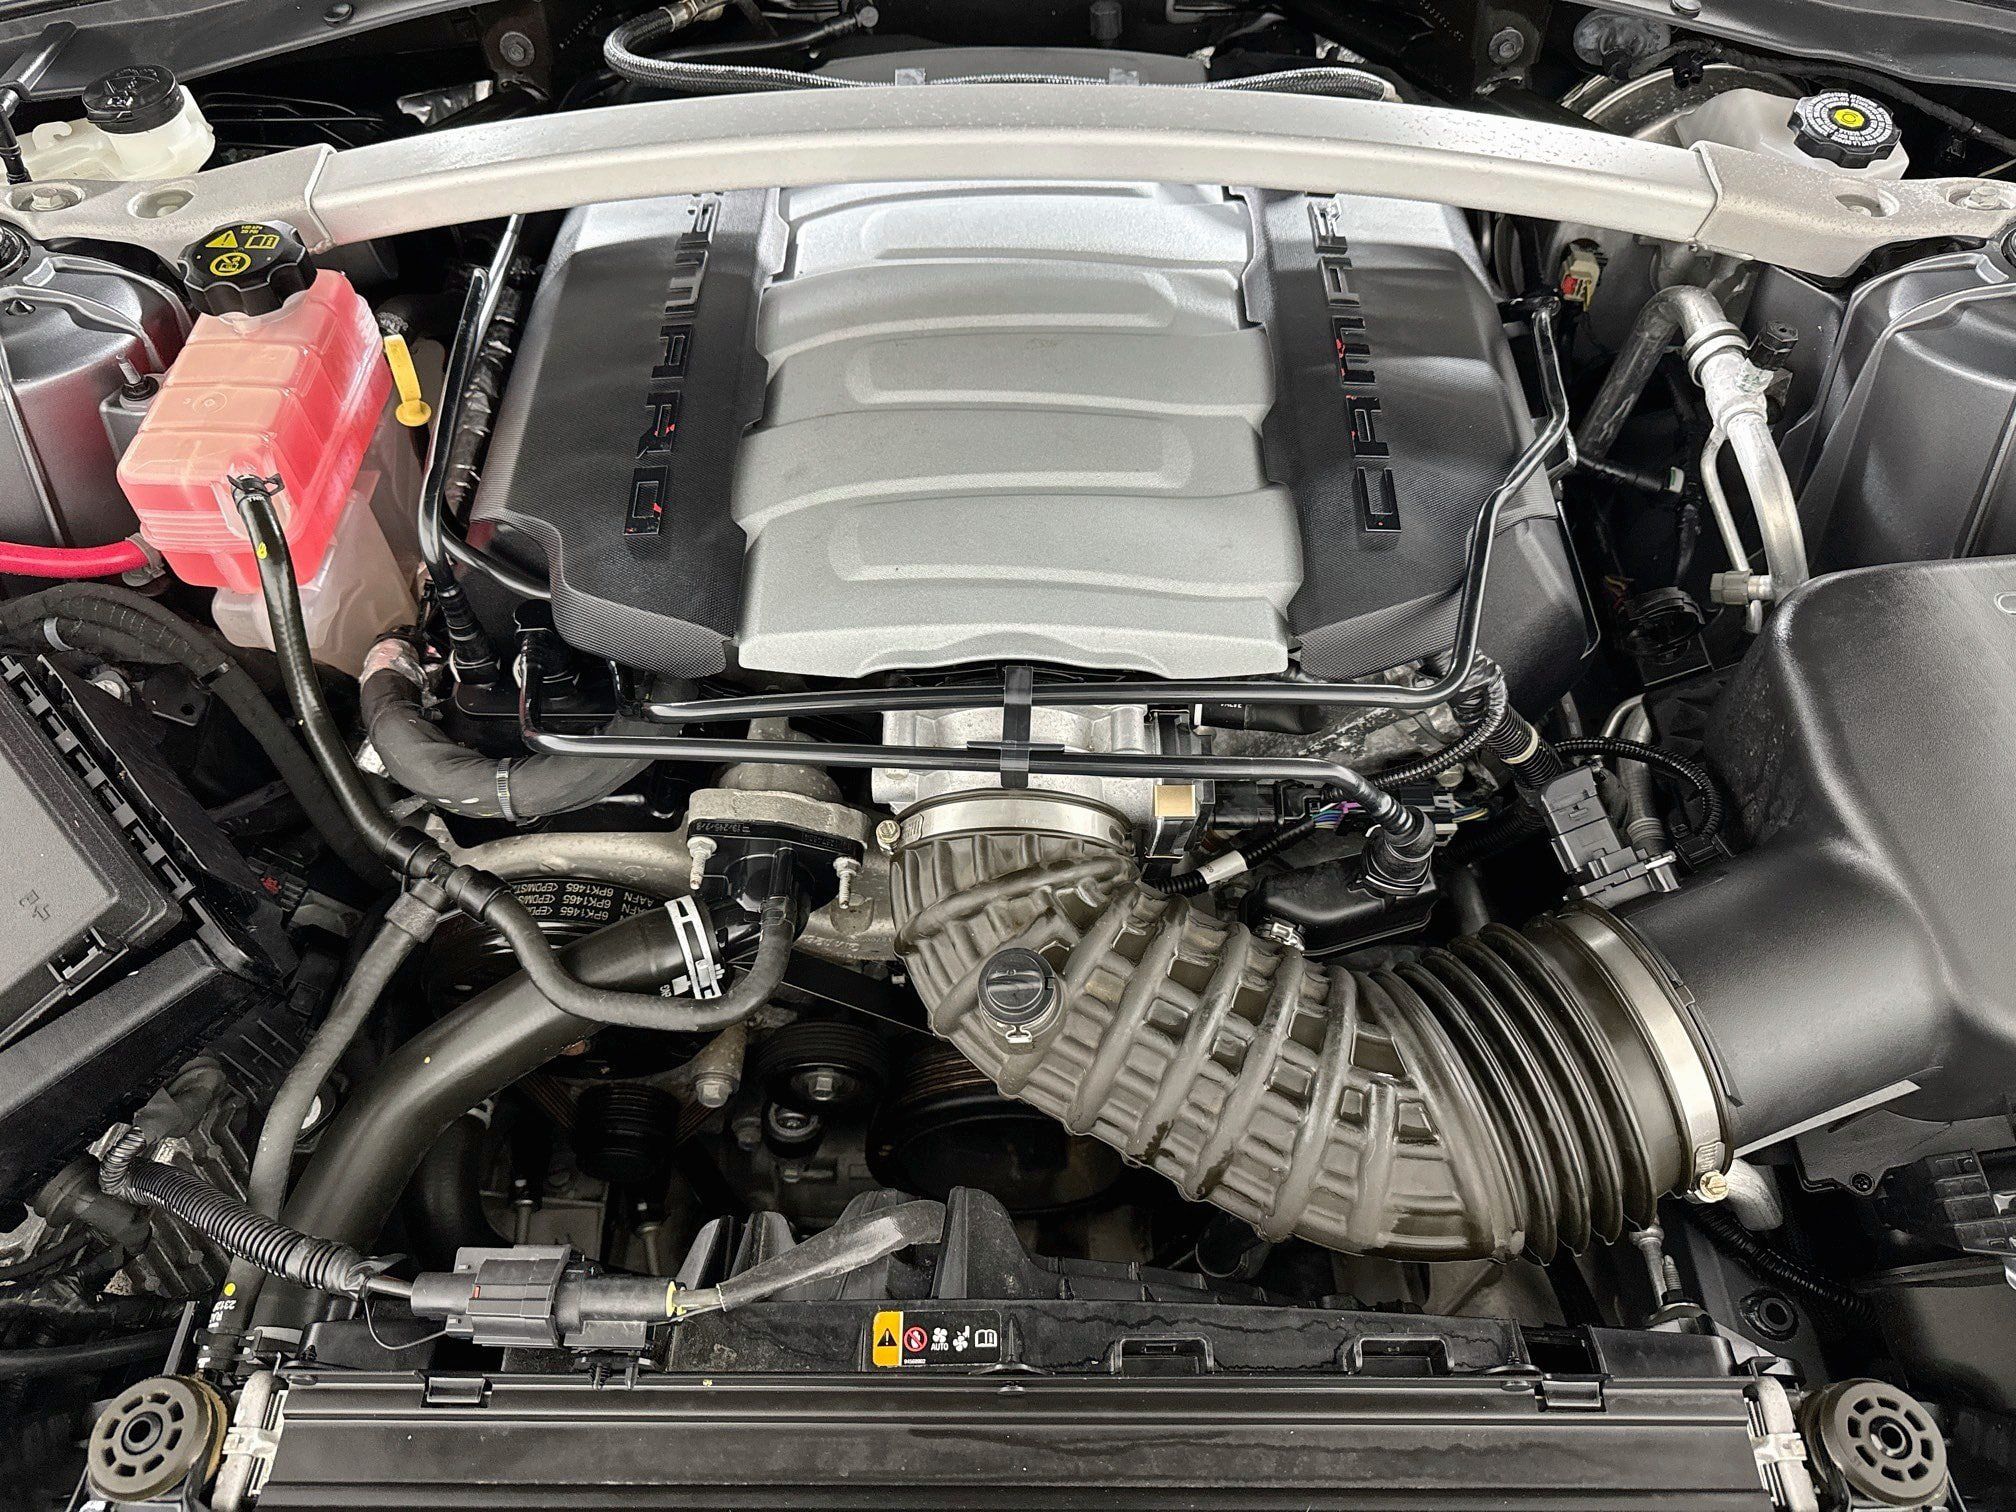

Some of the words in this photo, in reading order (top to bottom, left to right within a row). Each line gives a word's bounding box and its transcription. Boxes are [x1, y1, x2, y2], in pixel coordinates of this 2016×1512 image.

[623, 198, 721, 535] AMARO
[1307, 199, 1401, 533] CAMAR
[565, 882, 614, 897] 6PK1465
[563, 894, 612, 909] 6PK1465
[559, 906, 609, 921] 6PK1465
[930, 1342, 949, 1351] AUTO
